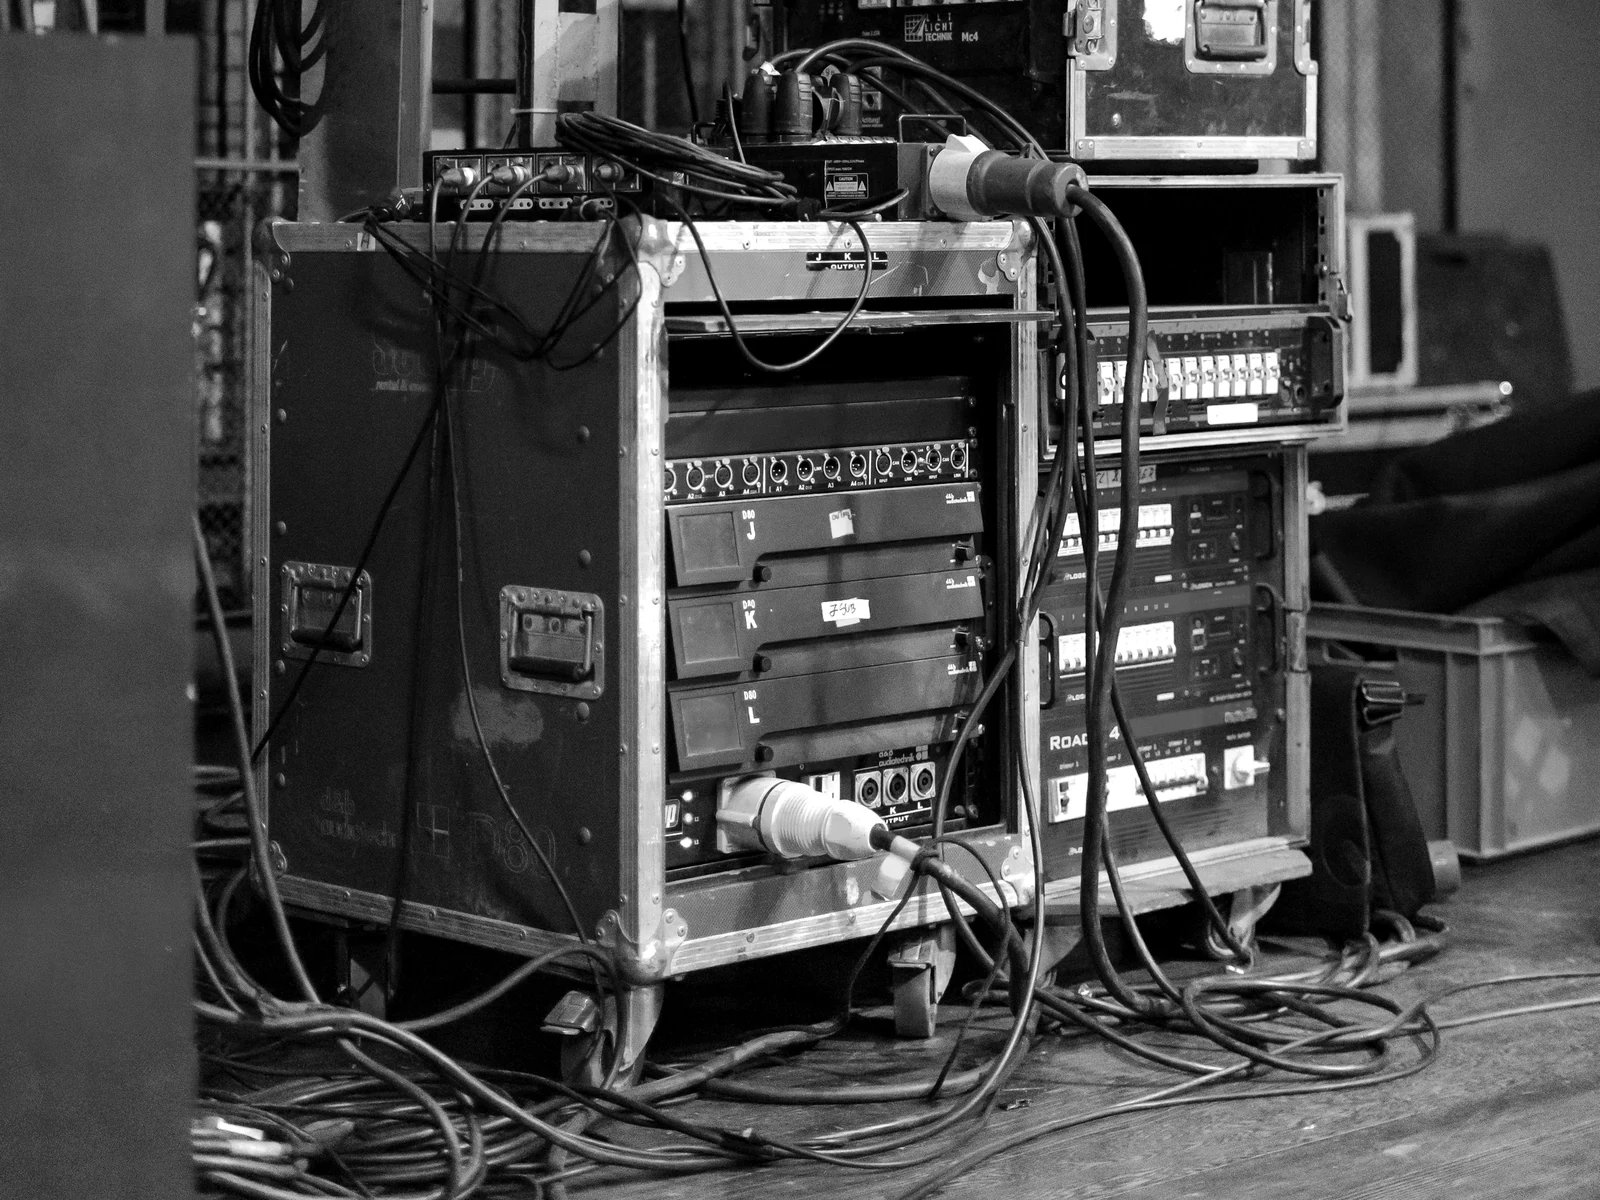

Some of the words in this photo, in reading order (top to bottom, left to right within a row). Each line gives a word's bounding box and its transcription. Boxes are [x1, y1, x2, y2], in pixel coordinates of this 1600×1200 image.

[924, 21, 953, 32] LICHT
[925, 32, 953, 41] TECHNIK
[961, 31, 979, 42] Mc4
[816, 253, 821, 261] J
[873, 252, 879, 260] L
[742, 509, 756, 520] D80
[746, 521, 756, 540] J
[742, 599, 756, 610] D80
[744, 610, 758, 630] K
[743, 689, 757, 701] D80
[748, 706, 760, 724] L
[1109, 725, 1120, 740] 4
[878, 753, 915, 767] audiotechnik
